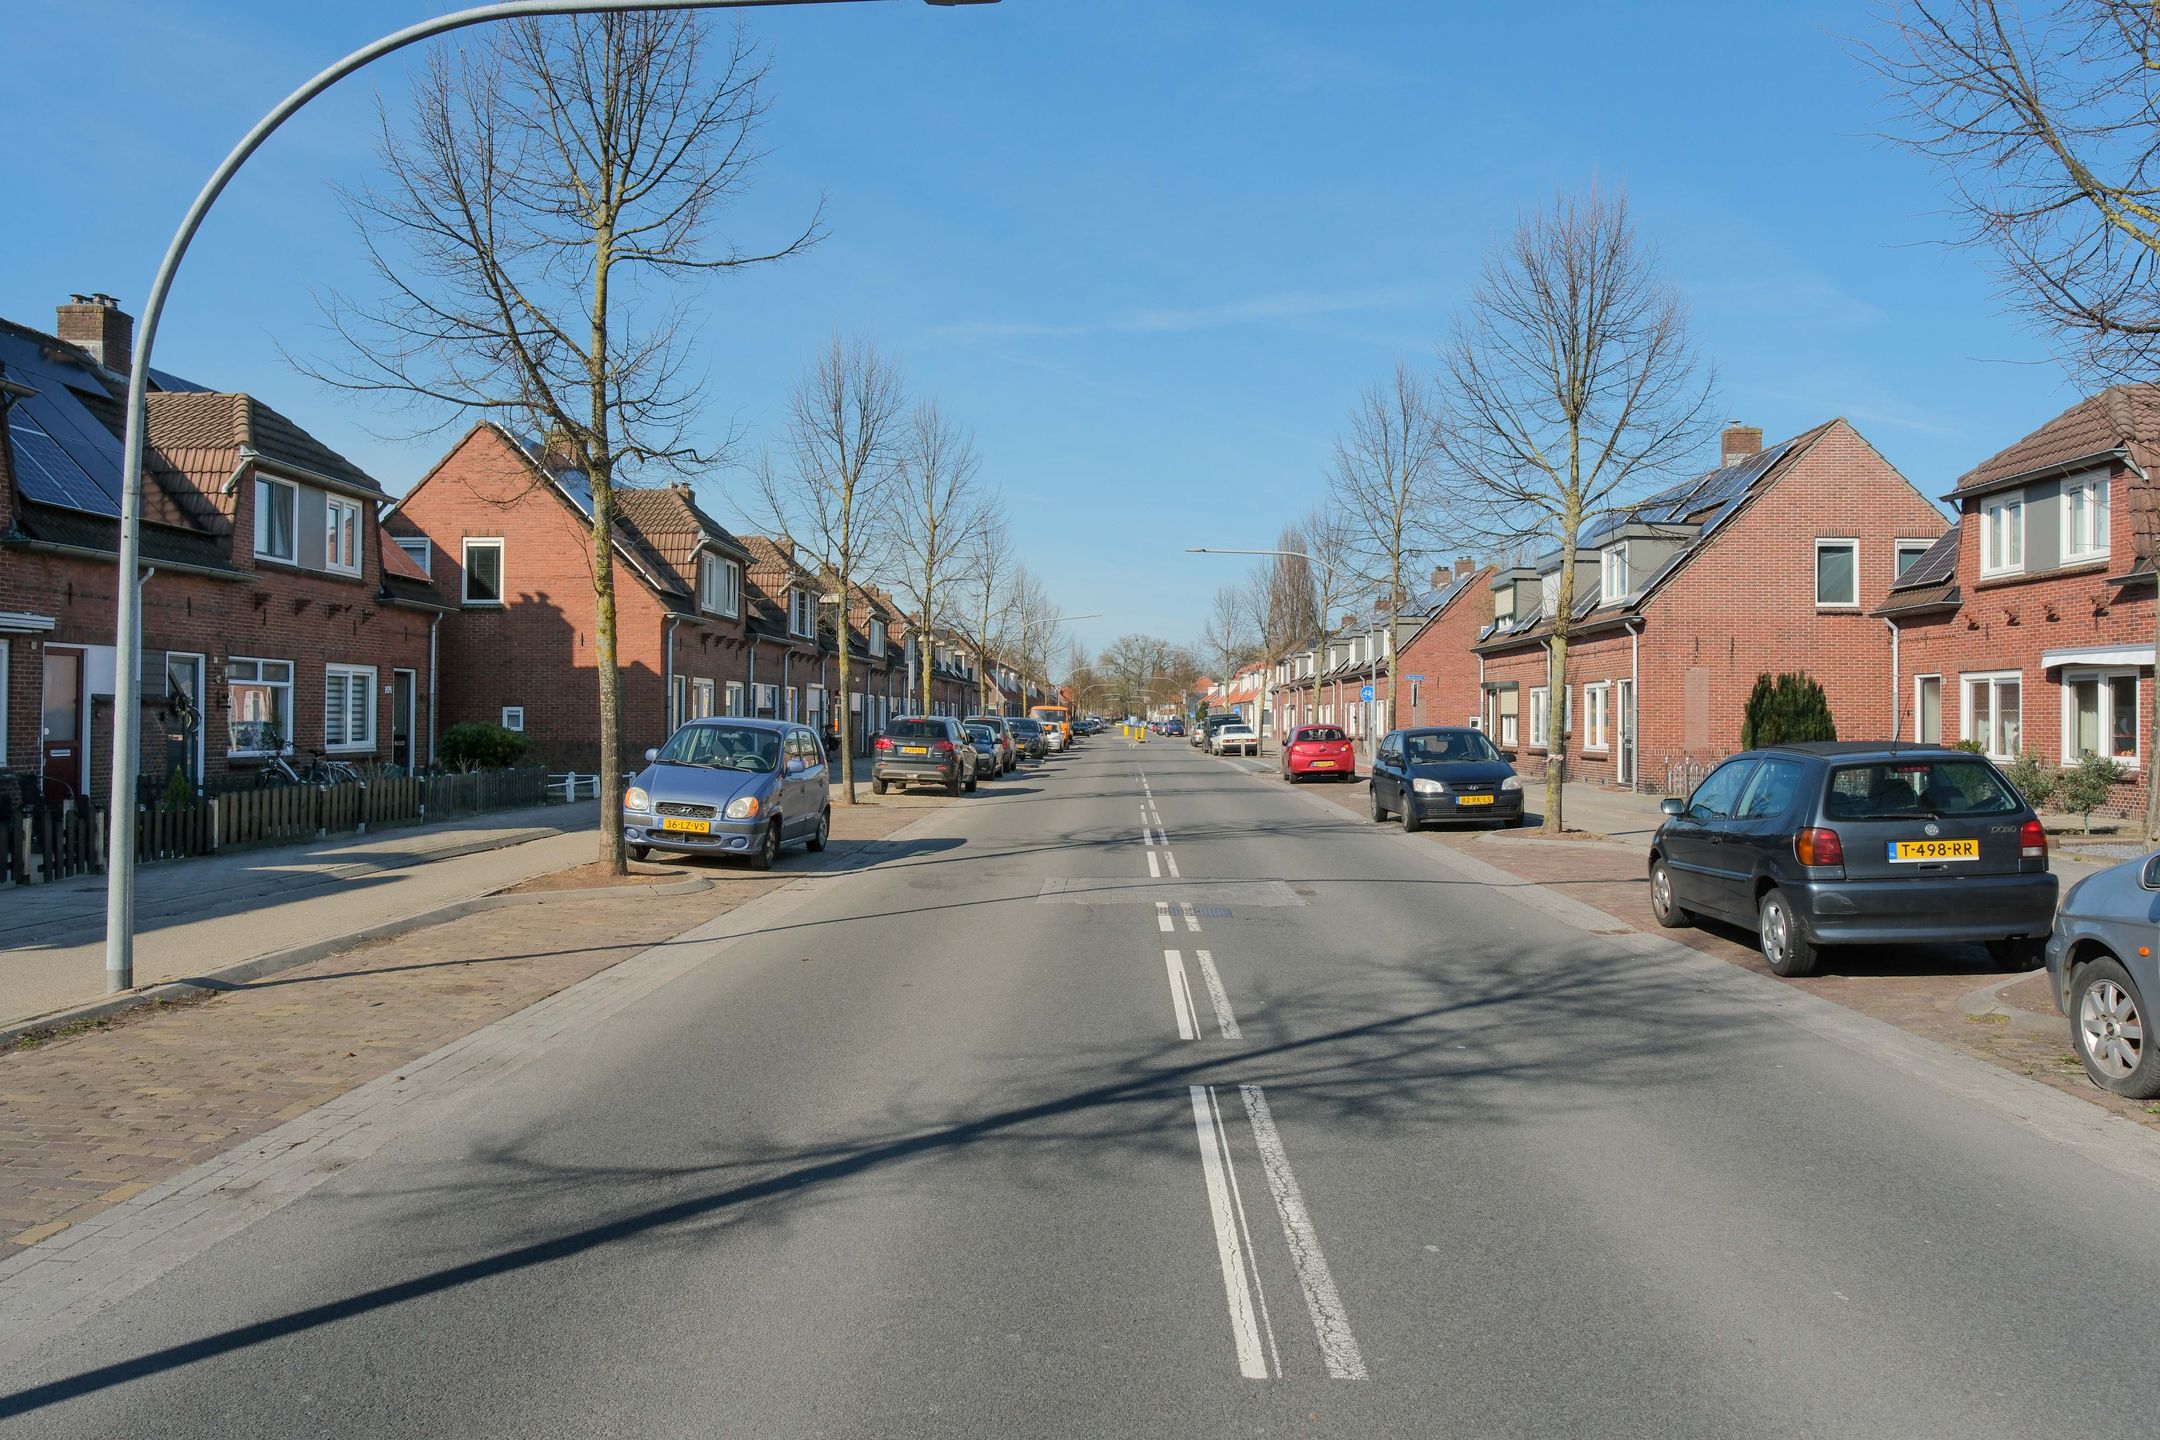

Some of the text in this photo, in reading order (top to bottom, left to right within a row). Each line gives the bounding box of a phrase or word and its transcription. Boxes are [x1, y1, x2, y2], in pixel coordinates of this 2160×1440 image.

[1461, 796, 1492, 804] 82-RK-LS
[666, 820, 705, 831] 36-LZ-VS
[1901, 842, 1973, 857] T-498-RR
